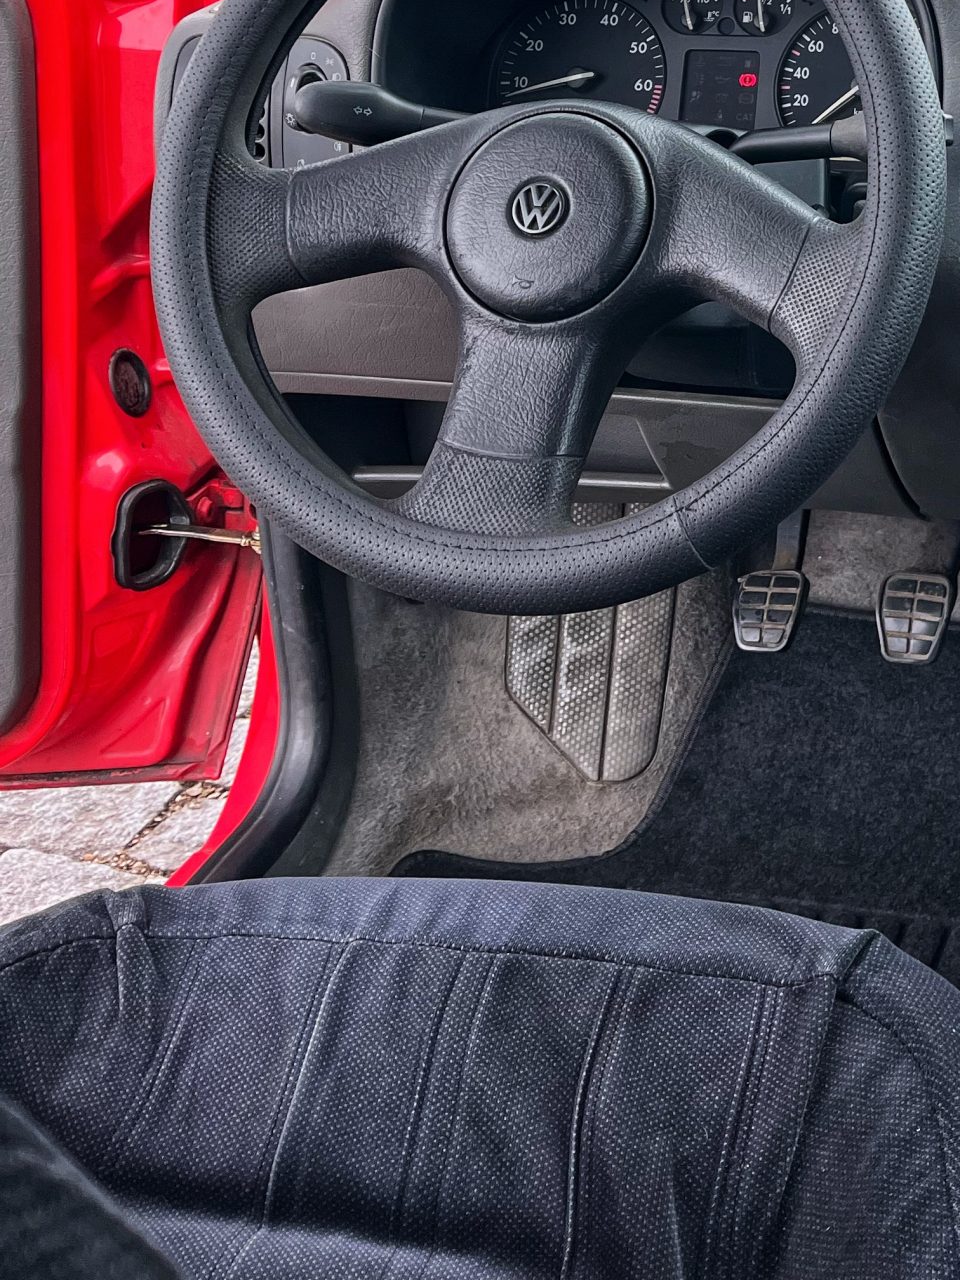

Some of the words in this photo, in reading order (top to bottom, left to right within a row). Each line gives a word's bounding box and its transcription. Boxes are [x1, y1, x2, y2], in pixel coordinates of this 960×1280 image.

[780, 3, 791, 15] 1/1
[559, 13, 577, 25] 30
[600, 14, 619, 26] 40
[525, 39, 544, 52] 20
[629, 41, 648, 54] 50
[807, 40, 824, 53] 60
[793, 67, 810, 79] 40
[513, 76, 528, 88] 10
[634, 79, 653, 91] 60
[793, 94, 809, 107] 20
[511, 183, 562, 234] VW
